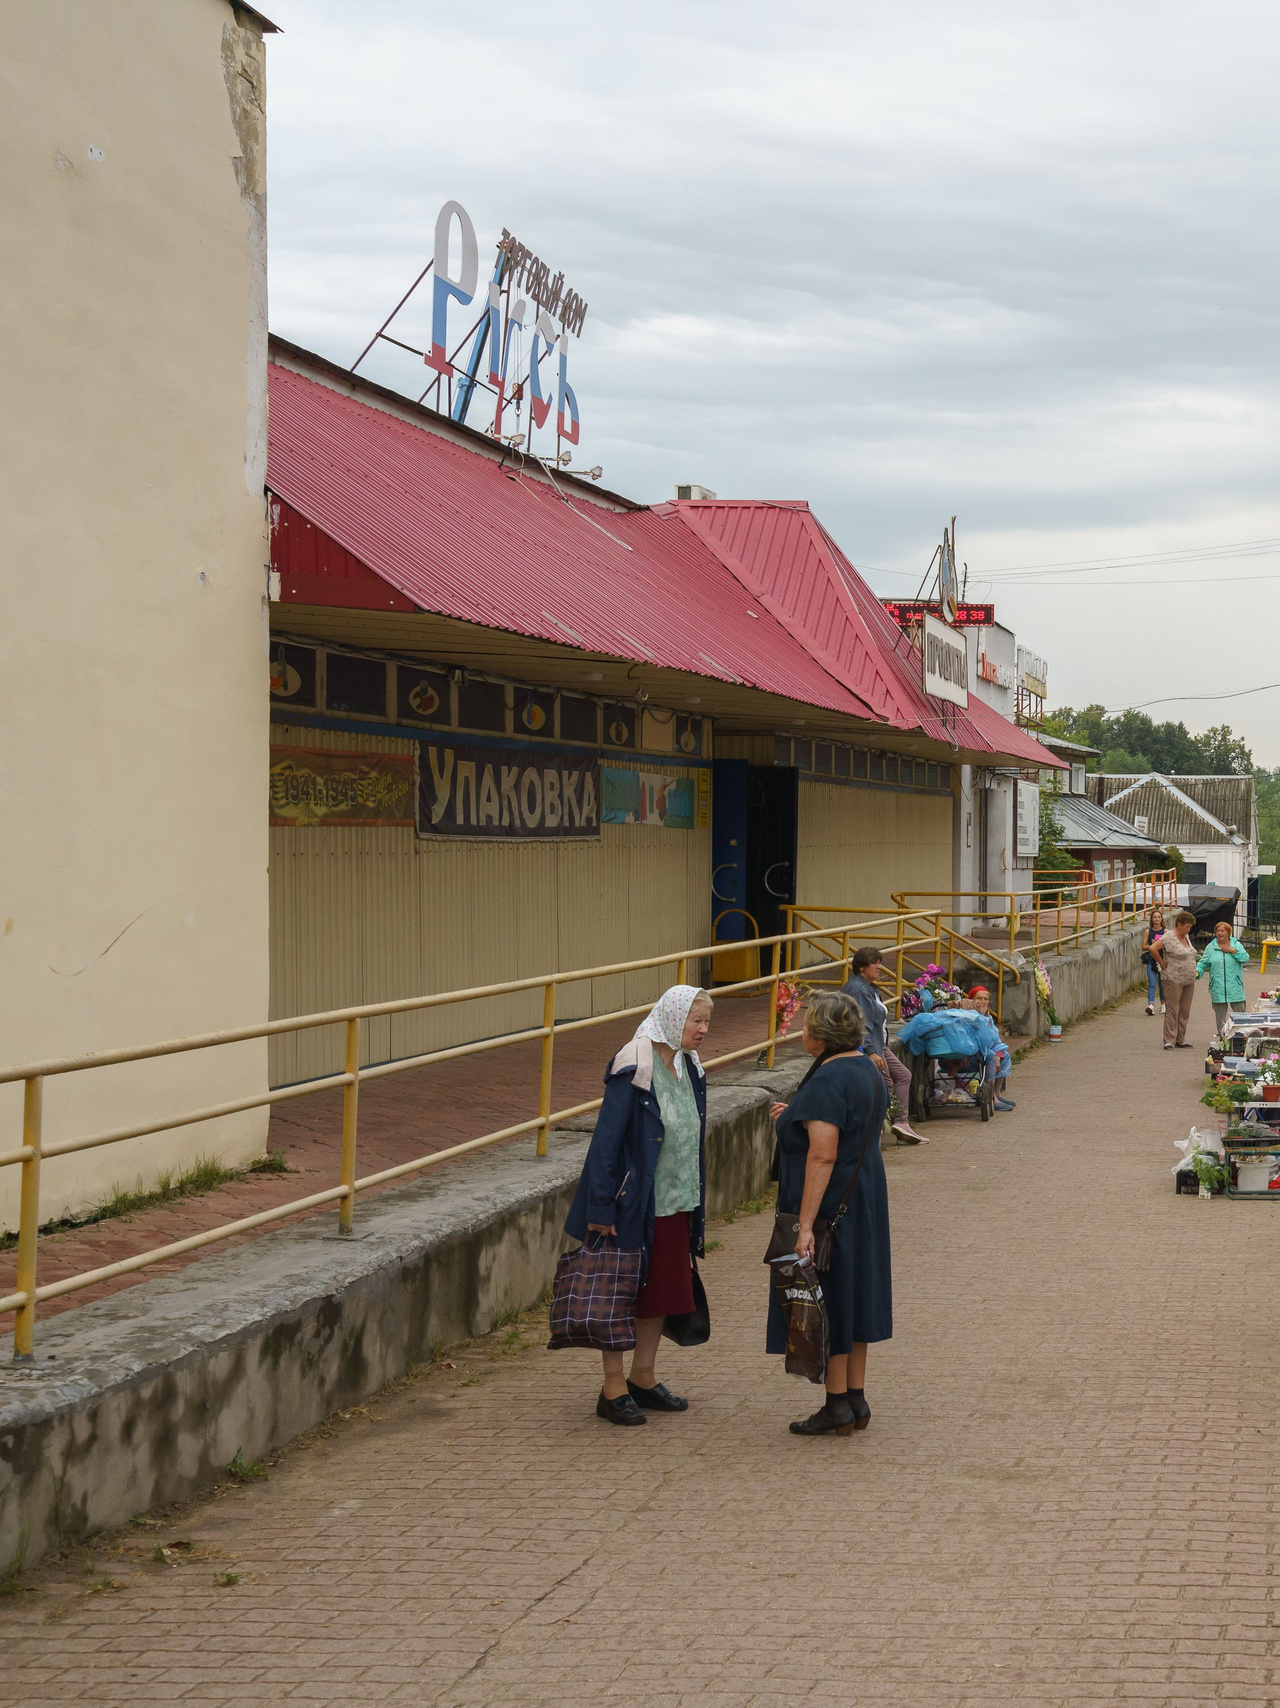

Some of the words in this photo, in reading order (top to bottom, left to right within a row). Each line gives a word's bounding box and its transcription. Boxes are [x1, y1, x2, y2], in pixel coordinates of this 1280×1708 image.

[424, 200, 580, 446] РУСЬ
[494, 227, 565, 317] ТОРГОВЫЙ
[558, 288, 588, 339] ДОМ
[282, 774, 359, 805] 1941-1945
[427, 746, 597, 829] УПАКОВКА
